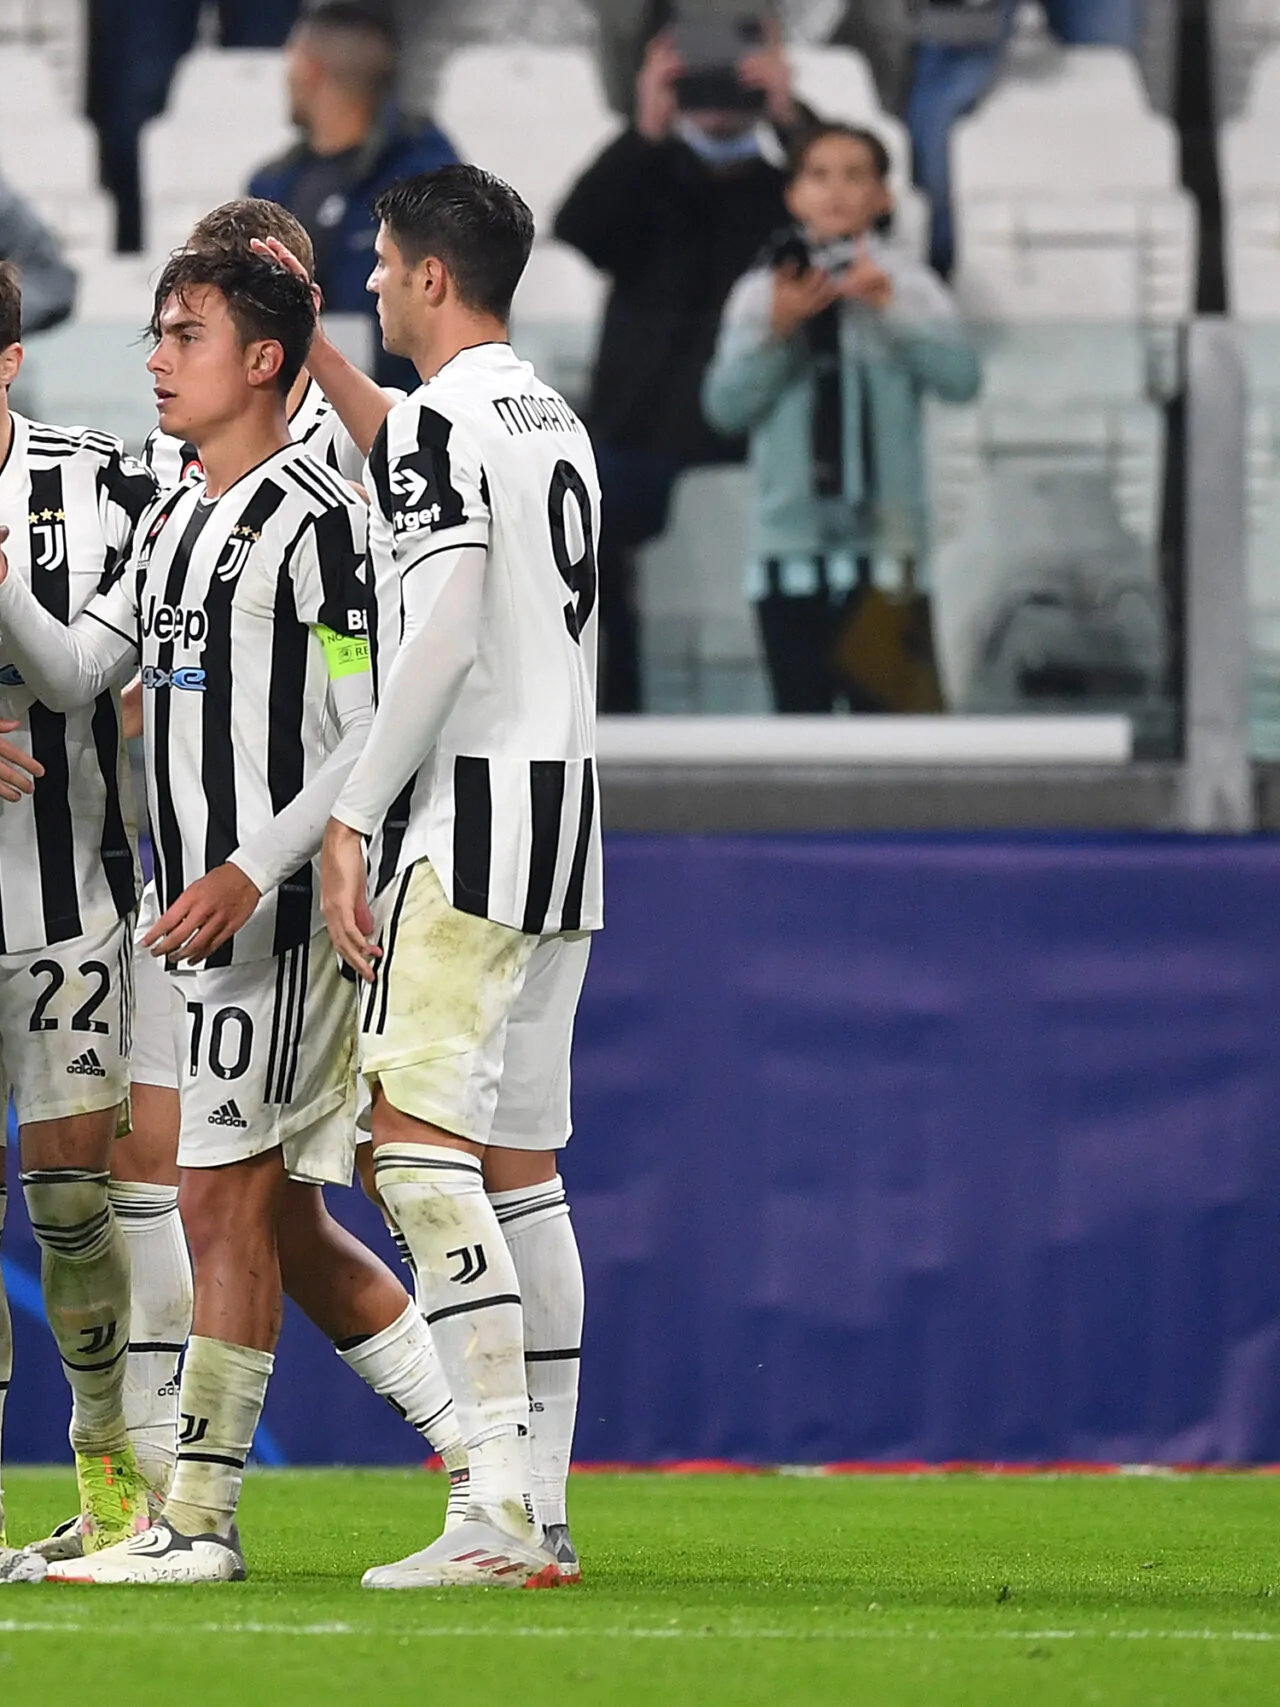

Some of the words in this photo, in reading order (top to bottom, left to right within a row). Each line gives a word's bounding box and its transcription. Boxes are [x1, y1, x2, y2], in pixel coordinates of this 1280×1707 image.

[392, 503, 442, 532] tget
[548, 459, 597, 647] 9
[141, 595, 207, 650] Jeep
[28, 959, 110, 1035] 22
[186, 1001, 255, 1081] 10
[66, 1064, 107, 1078] adidas
[207, 1115, 248, 1129] adidas
